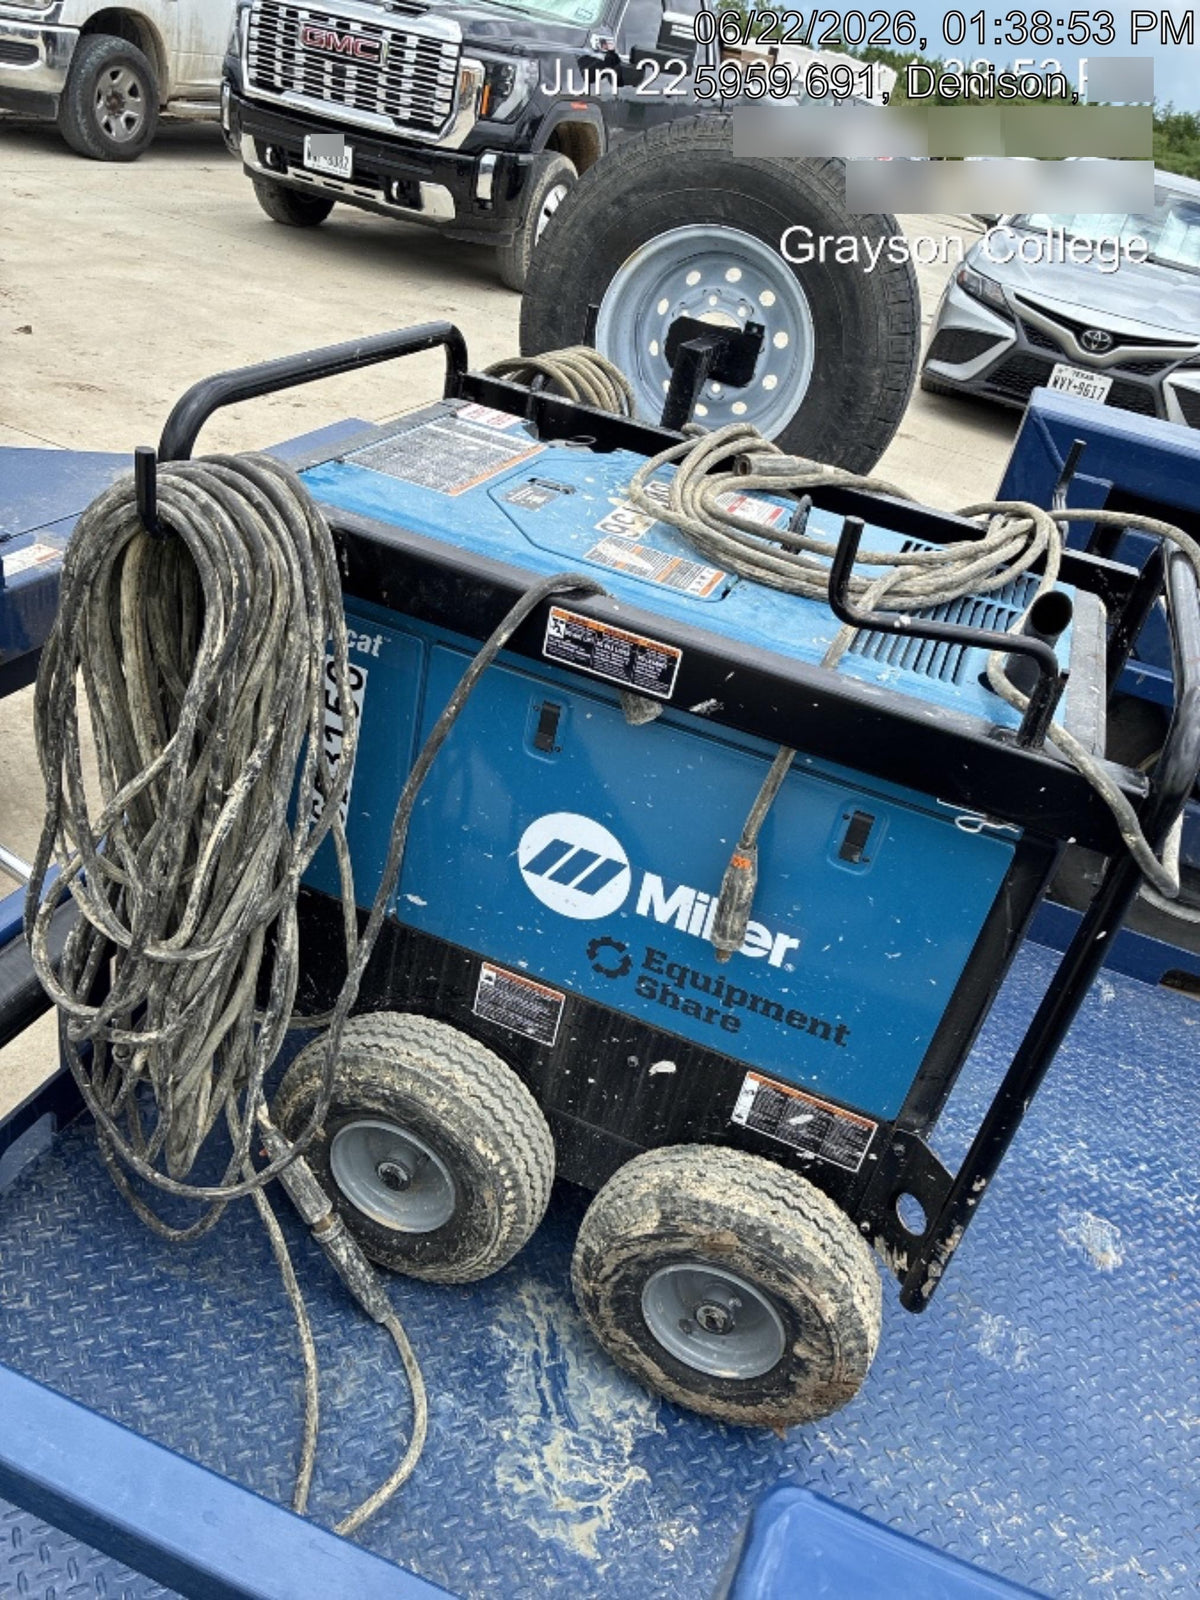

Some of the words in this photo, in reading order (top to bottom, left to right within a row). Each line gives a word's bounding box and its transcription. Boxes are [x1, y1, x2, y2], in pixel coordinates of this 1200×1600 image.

[303, 26, 379, 62] GMC
[635, 872, 801, 968] Miler
[634, 975, 741, 1034] Share
[642, 946, 851, 1048] Equipment
